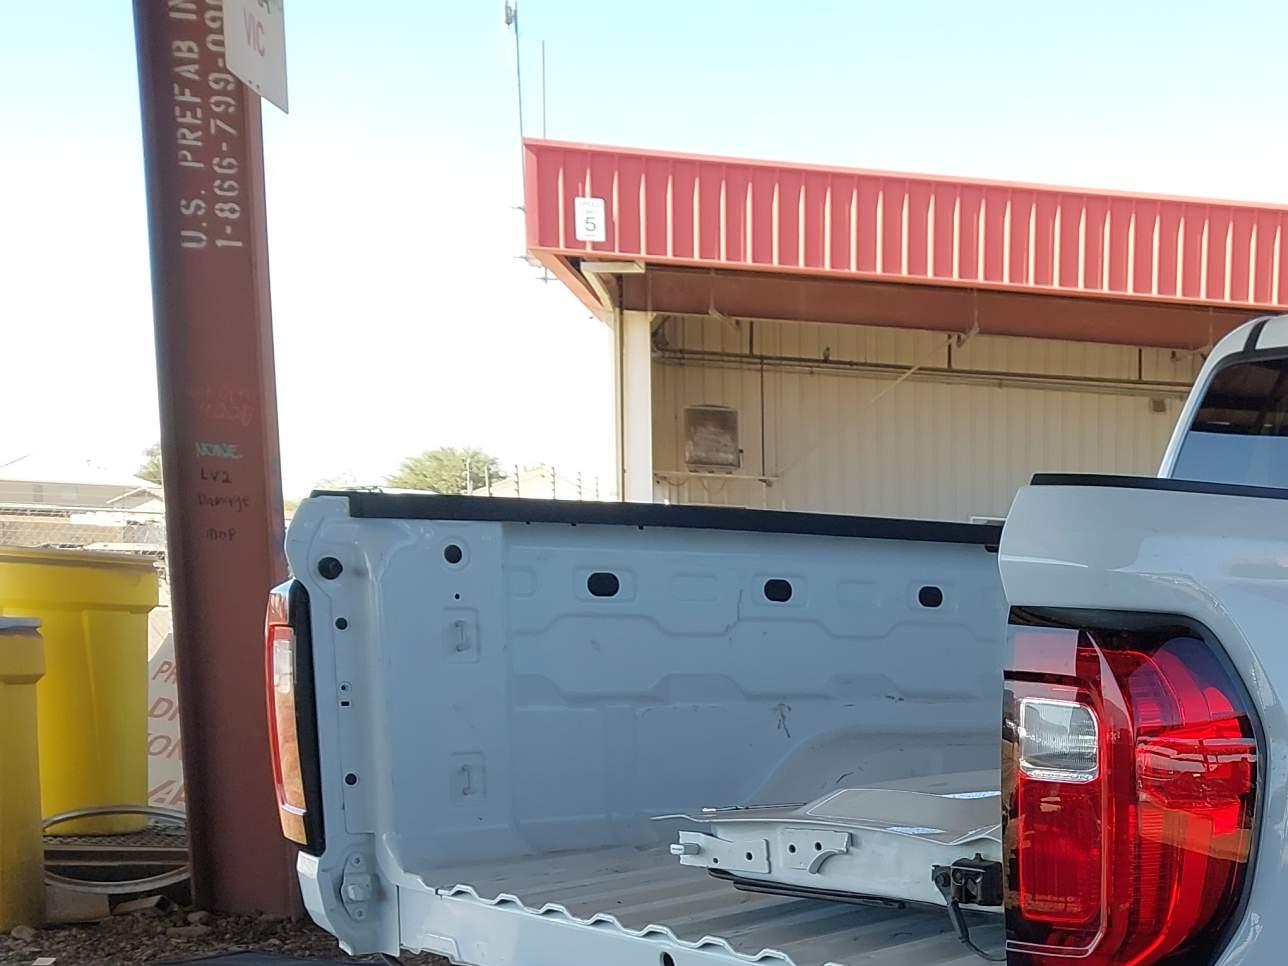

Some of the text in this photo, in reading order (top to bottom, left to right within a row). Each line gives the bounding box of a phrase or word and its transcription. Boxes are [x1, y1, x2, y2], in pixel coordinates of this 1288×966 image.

[172, 40, 205, 168] PREFAB
[180, 189, 208, 249] U.S.
[585, 217, 597, 232] 5
